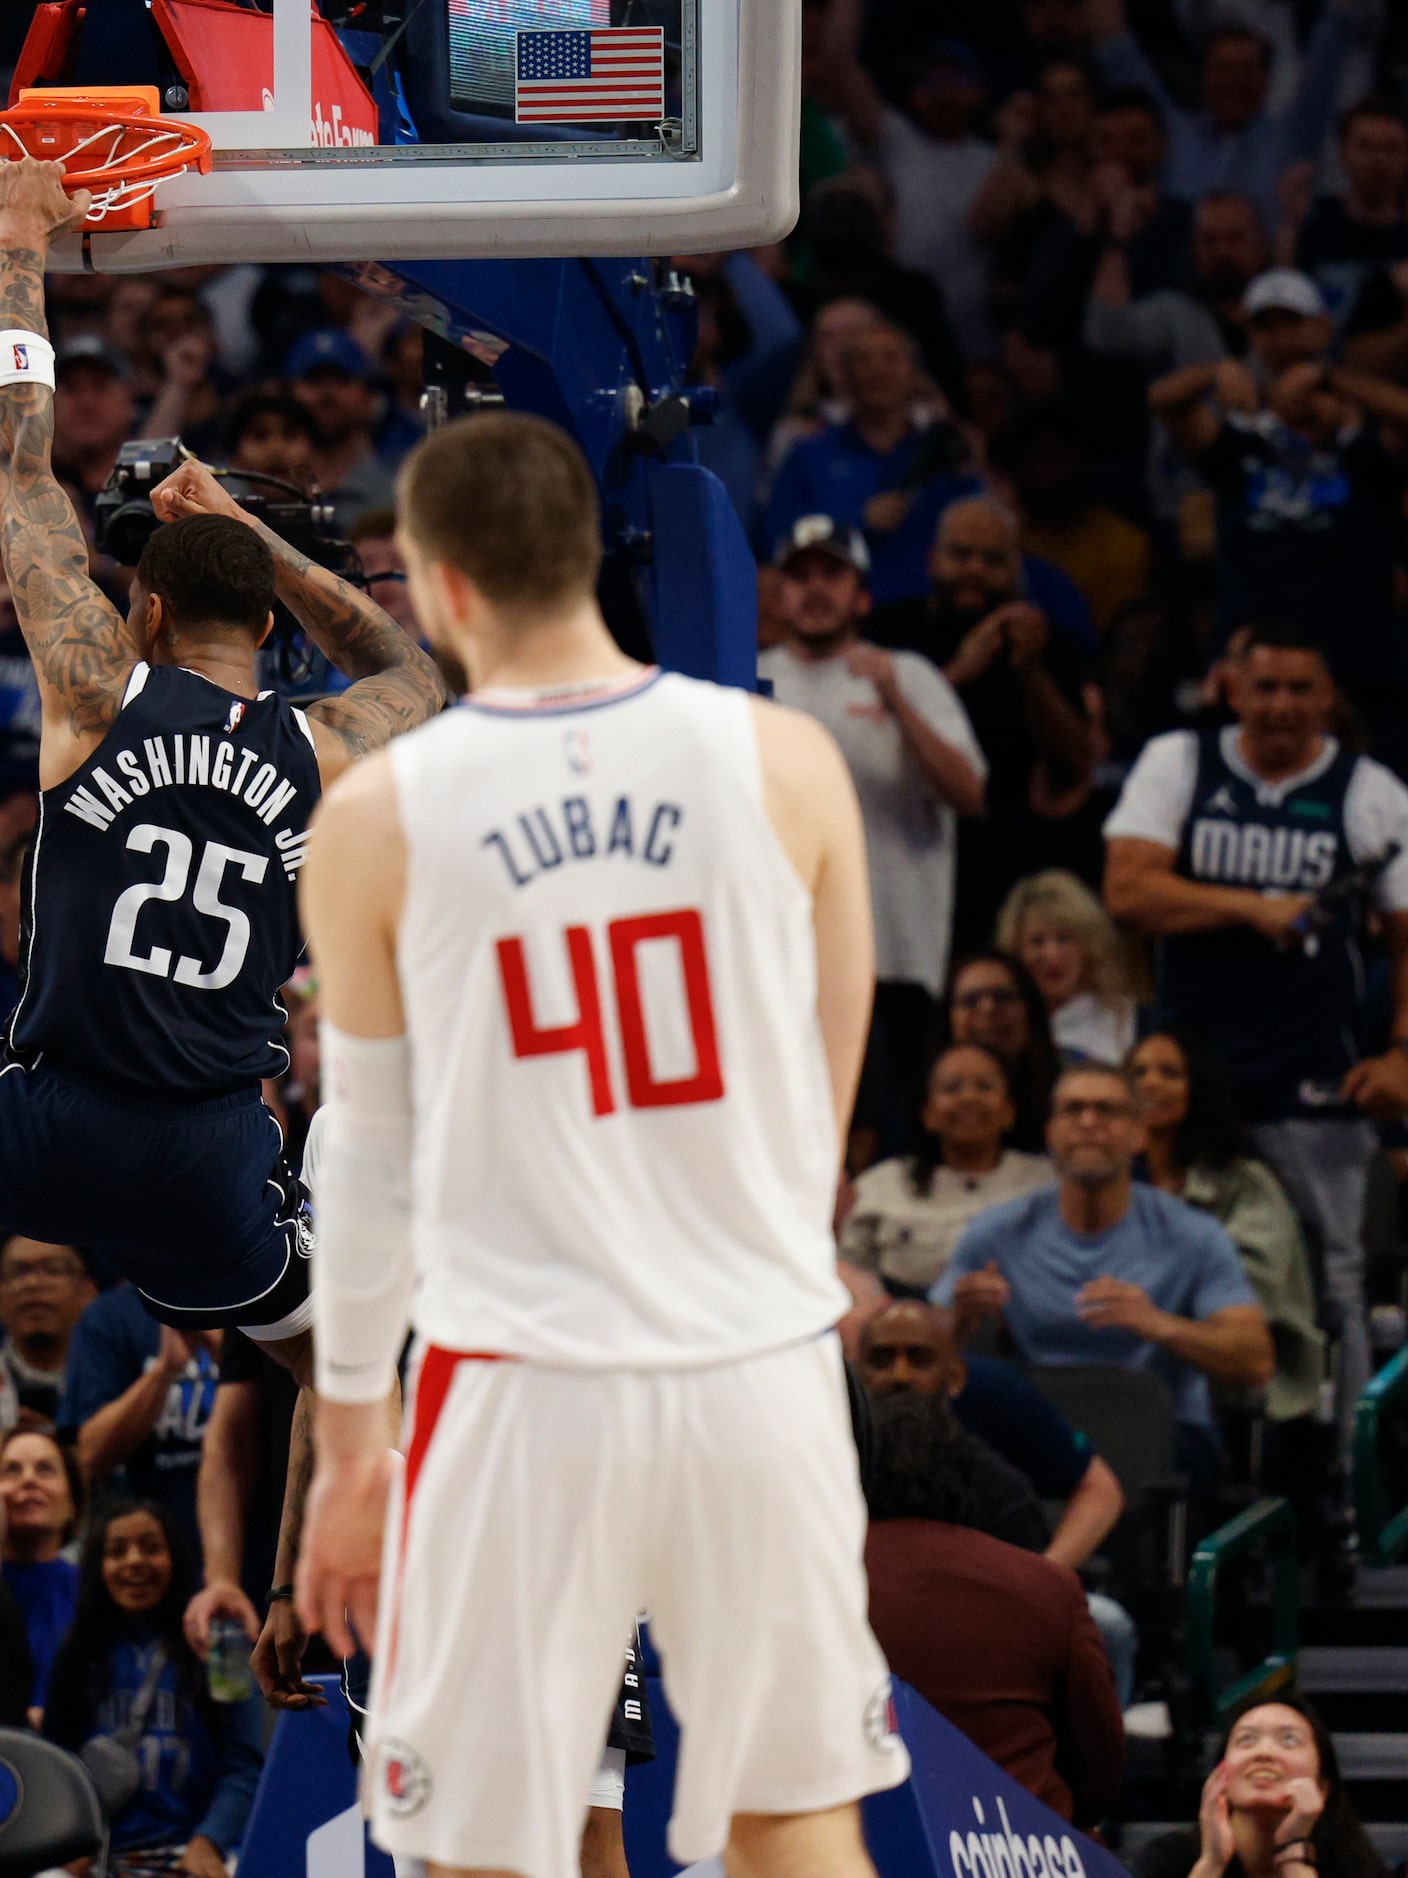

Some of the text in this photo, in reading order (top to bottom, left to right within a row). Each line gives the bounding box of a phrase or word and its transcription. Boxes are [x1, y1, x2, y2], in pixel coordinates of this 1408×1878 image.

[64, 733, 298, 832] WASHINGTON
[480, 795, 683, 887] ZUBAC
[104, 823, 270, 990] 25
[495, 908, 726, 1118] 40
